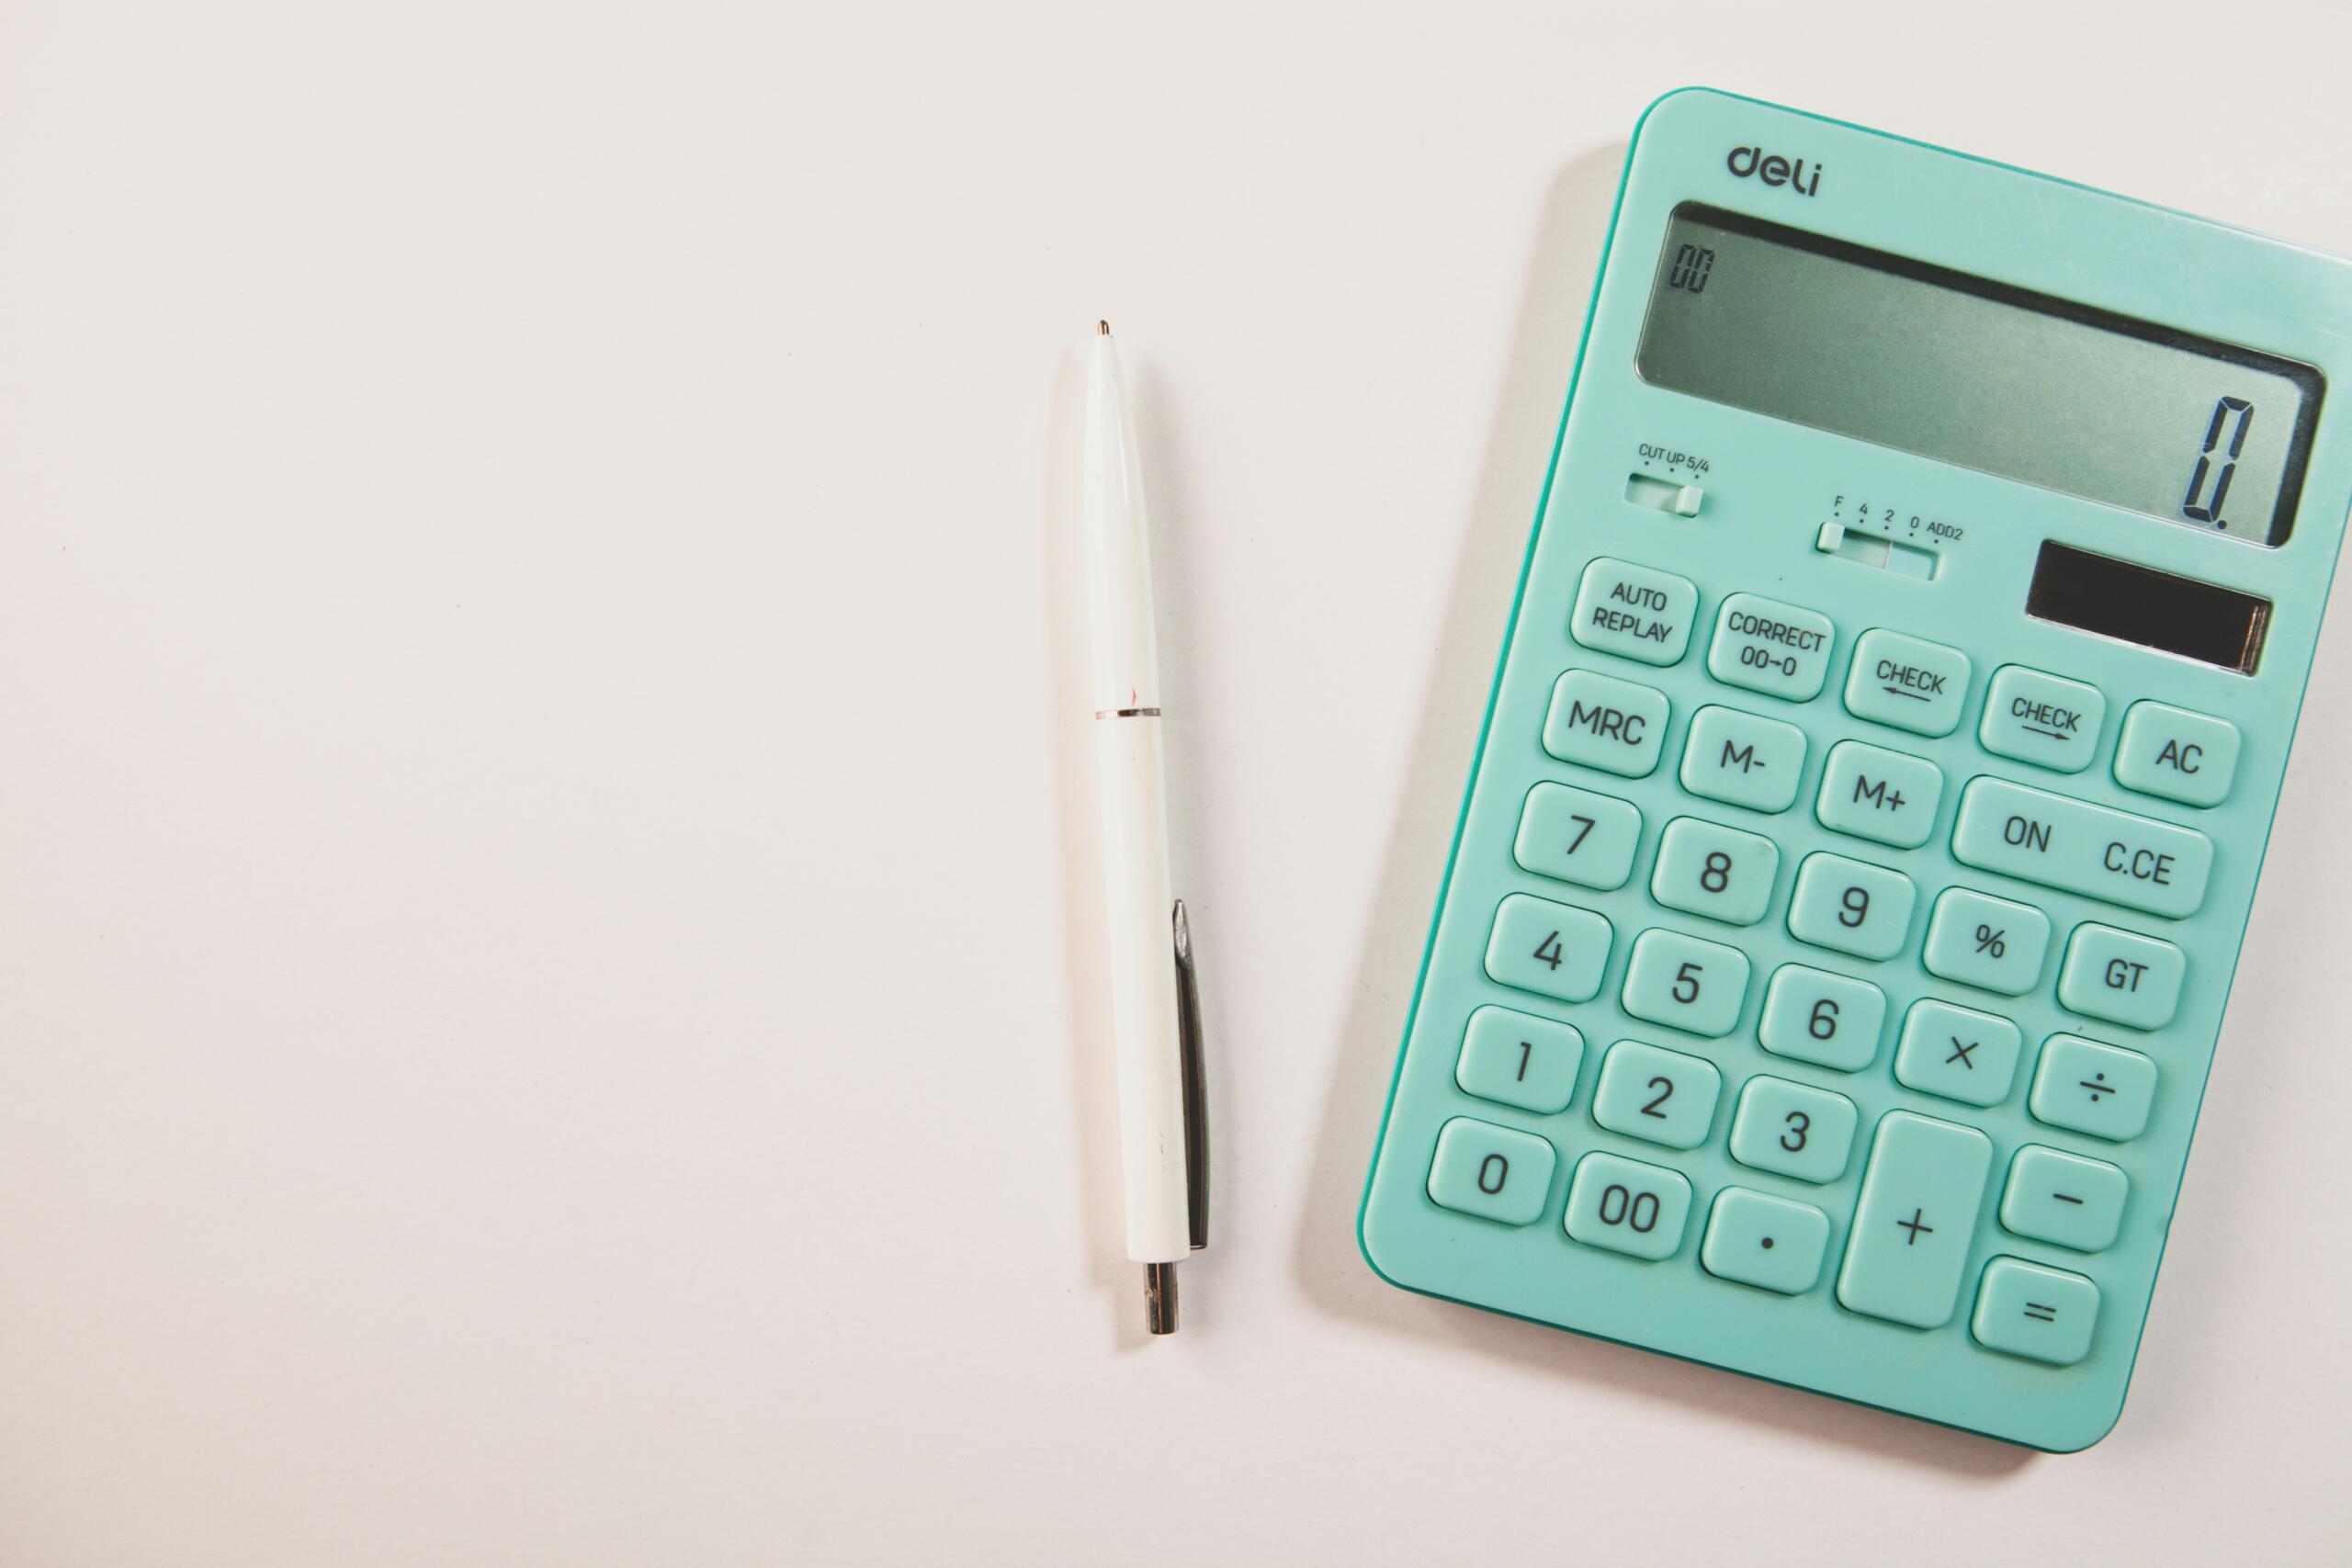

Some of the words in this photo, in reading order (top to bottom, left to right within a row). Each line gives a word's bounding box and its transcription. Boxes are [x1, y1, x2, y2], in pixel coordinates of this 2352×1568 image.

[1726, 146, 1823, 197] deli
[1668, 243, 1714, 294] 00
[1638, 443, 1666, 460] CUT
[1667, 448, 1686, 465] UP
[1686, 456, 1709, 472] 5/4
[1834, 495, 1844, 507] F
[1859, 503, 1868, 515] 4
[1884, 509, 1894, 522] 2
[1910, 515, 1920, 529] 0
[1926, 521, 1963, 540] ADD2
[1610, 581, 1668, 612] AUTO
[1592, 606, 1673, 643] REPLAY
[1728, 611, 1826, 653] CORRECT
[1876, 659, 1947, 694] CHECK
[1568, 700, 1646, 746] MRC
[2011, 697, 2081, 731] CHECK
[1720, 739, 1766, 773] M-
[2155, 739, 2203, 774] AC
[1852, 774, 1905, 812] M+
[1566, 815, 1596, 855] 7
[2004, 815, 2052, 853] ON
[2103, 841, 2176, 886] C.CE
[1700, 852, 1732, 894] 8
[1838, 886, 1870, 928] 9
[1532, 931, 1563, 971] 4
[1975, 924, 2006, 959] %
[1671, 962, 1703, 1004] 5
[2105, 958, 2149, 993] GT
[1808, 998, 1839, 1041] 6
[1517, 1042, 1532, 1082] 1
[1640, 1076, 1674, 1120] 2
[1780, 1111, 1810, 1153] 3
[1477, 1153, 1509, 1195] 0
[1599, 1184, 1660, 1234] 00
[1896, 1208, 1934, 1246] +
[2023, 1302, 2057, 1323] =
